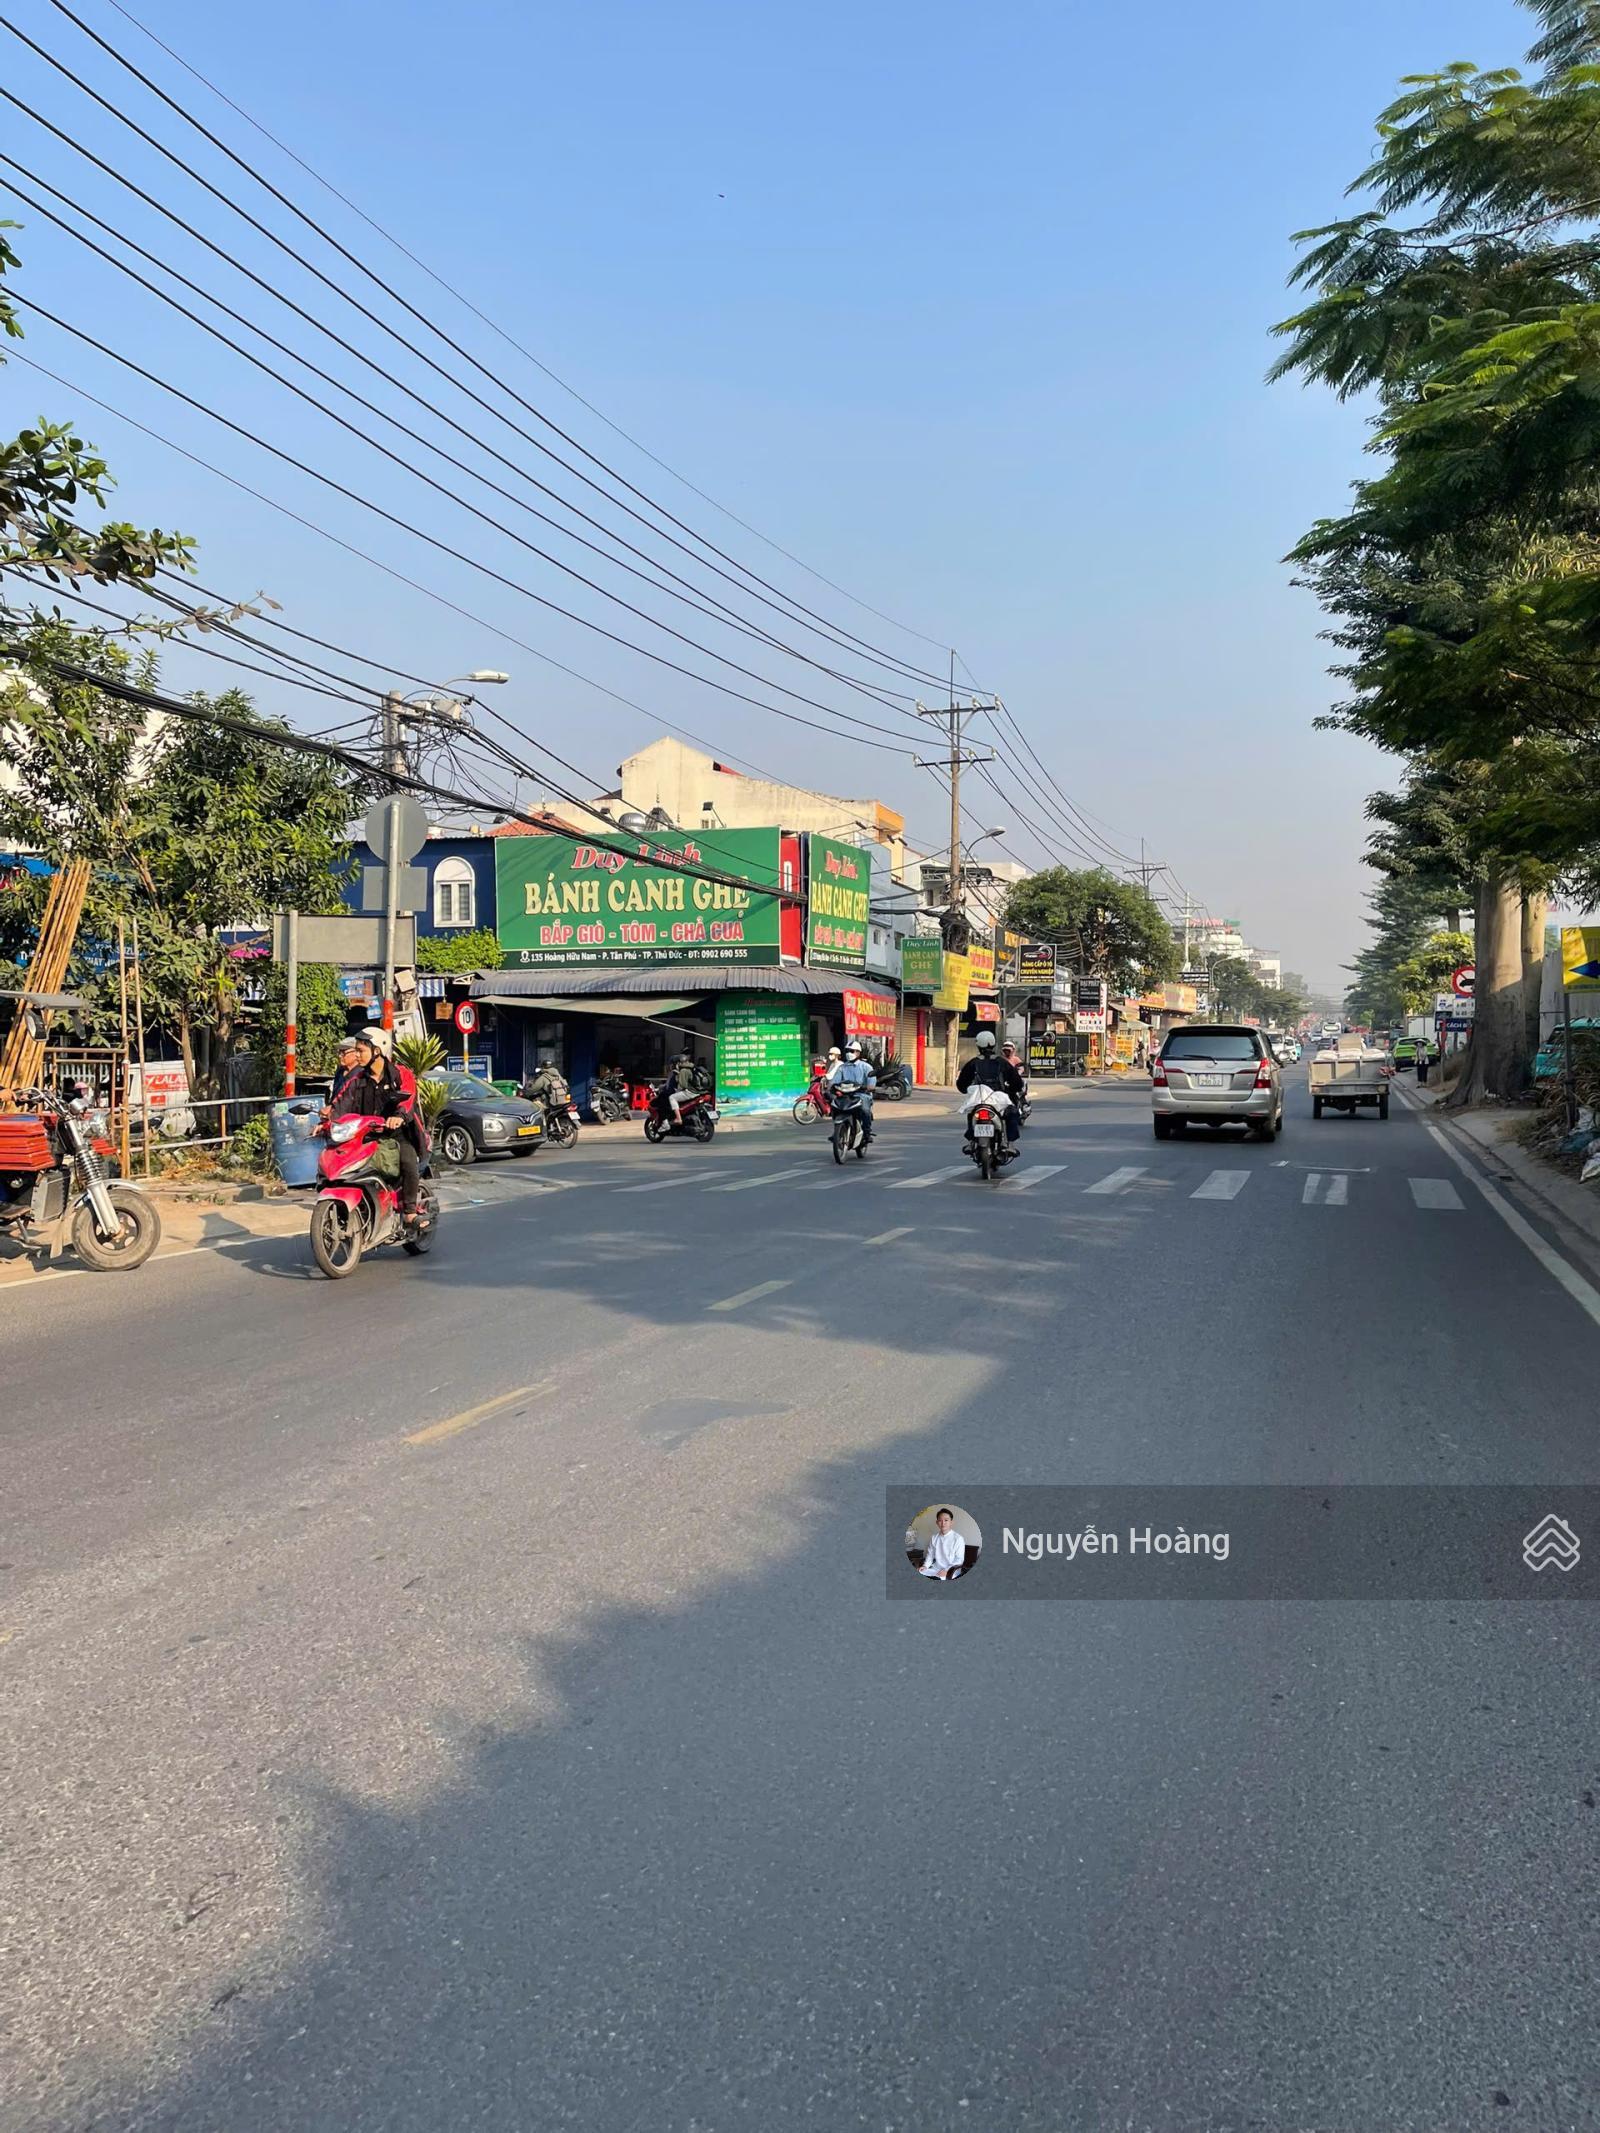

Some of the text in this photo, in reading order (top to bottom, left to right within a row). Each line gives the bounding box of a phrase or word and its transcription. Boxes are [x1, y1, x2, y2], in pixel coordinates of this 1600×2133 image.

[571, 846, 629, 875] Duy
[525, 873, 600, 915] BÁNH
[607, 877, 685, 913] CANH
[692, 875, 750, 919] GHẸ
[811, 873, 832, 916] BÁNH
[833, 885, 853, 919] CANH
[540, 918, 574, 945] BẮP
[577, 920, 605, 944] GIÒ
[620, 920, 656, 944] TÔM
[672, 916, 706, 942] CHẢ
[710, 920, 744, 942] CUA
[531, 953, 543, 962] 135
[581, 952, 597, 960] Nam
[701, 949, 719, 958] 0902
[720, 949, 733, 958] 690
[734, 949, 748, 957] 555
[462, 1010, 471, 1023] 10
[1030, 1042, 1056, 1057] RỬA XE
